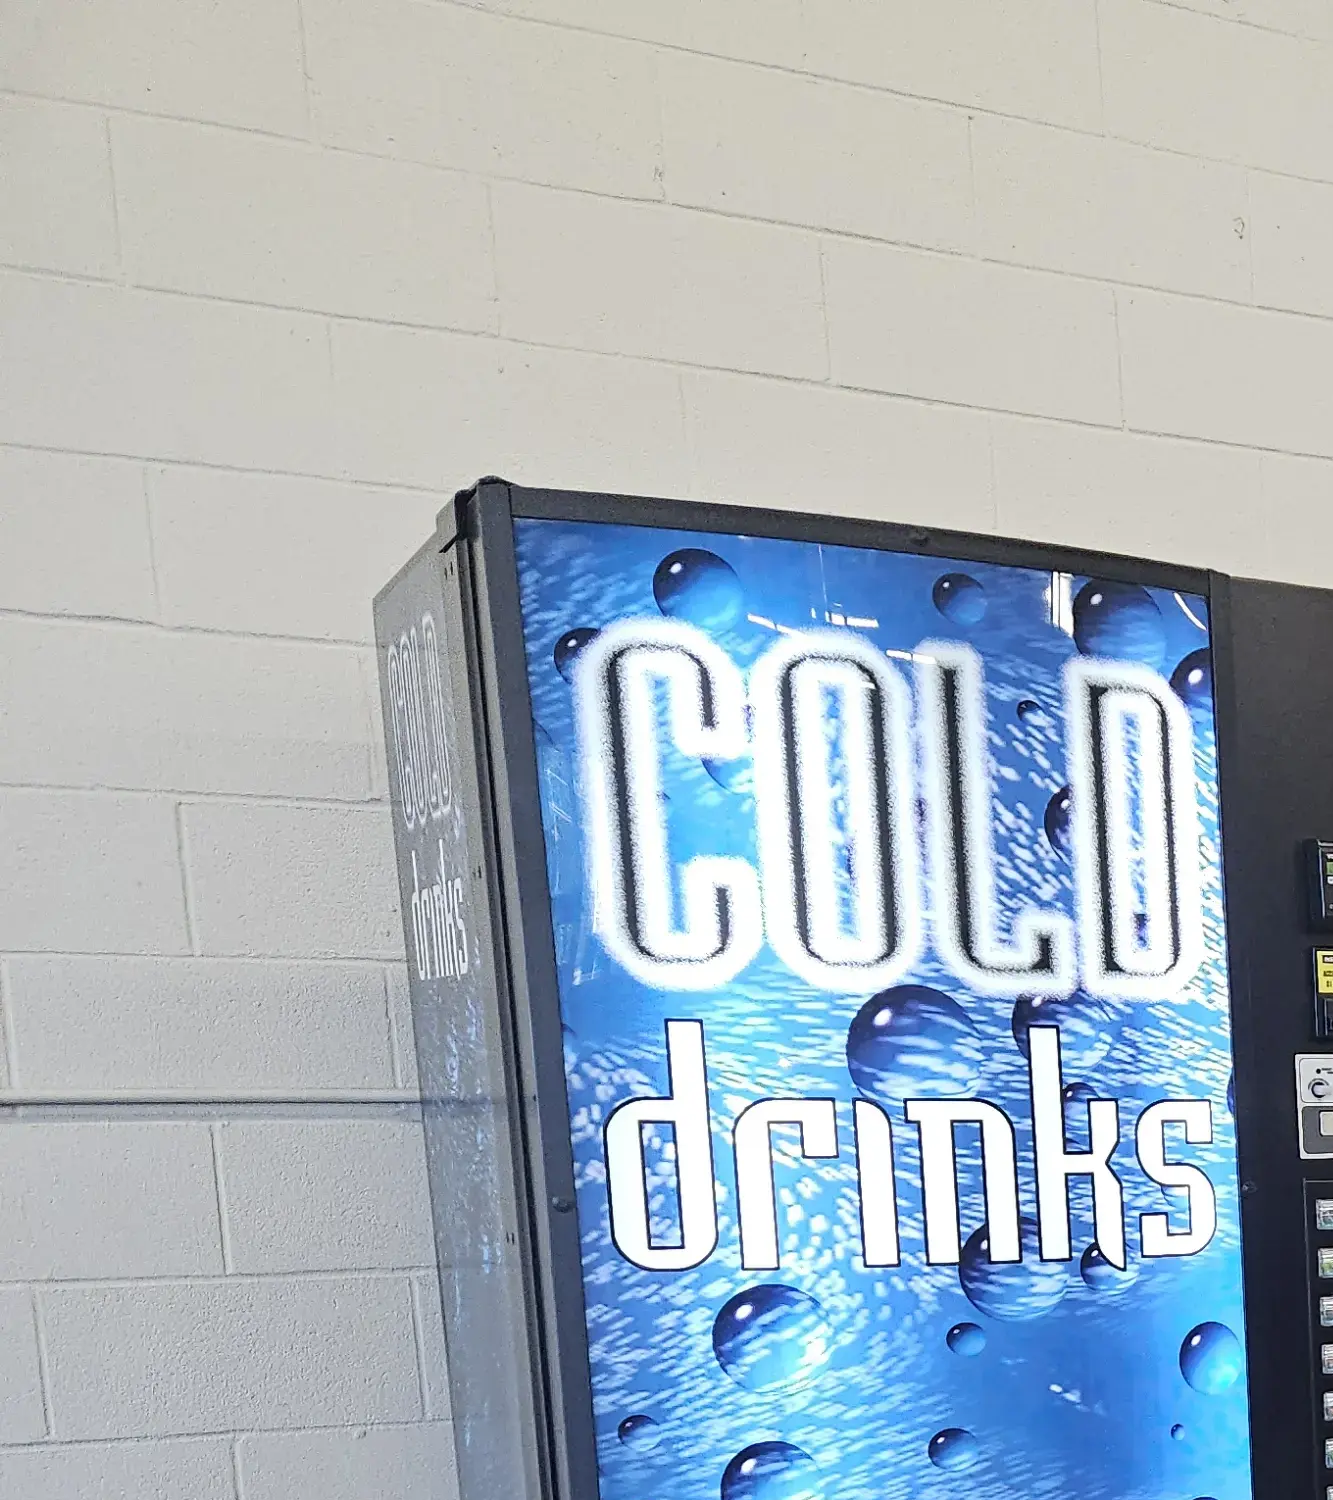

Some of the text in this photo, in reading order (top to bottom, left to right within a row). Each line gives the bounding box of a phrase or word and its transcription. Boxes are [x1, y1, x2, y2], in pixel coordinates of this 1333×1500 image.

[411, 839, 469, 981] drinks
[578, 618, 1196, 998] COLD
[604, 1018, 1217, 1272] drinks
